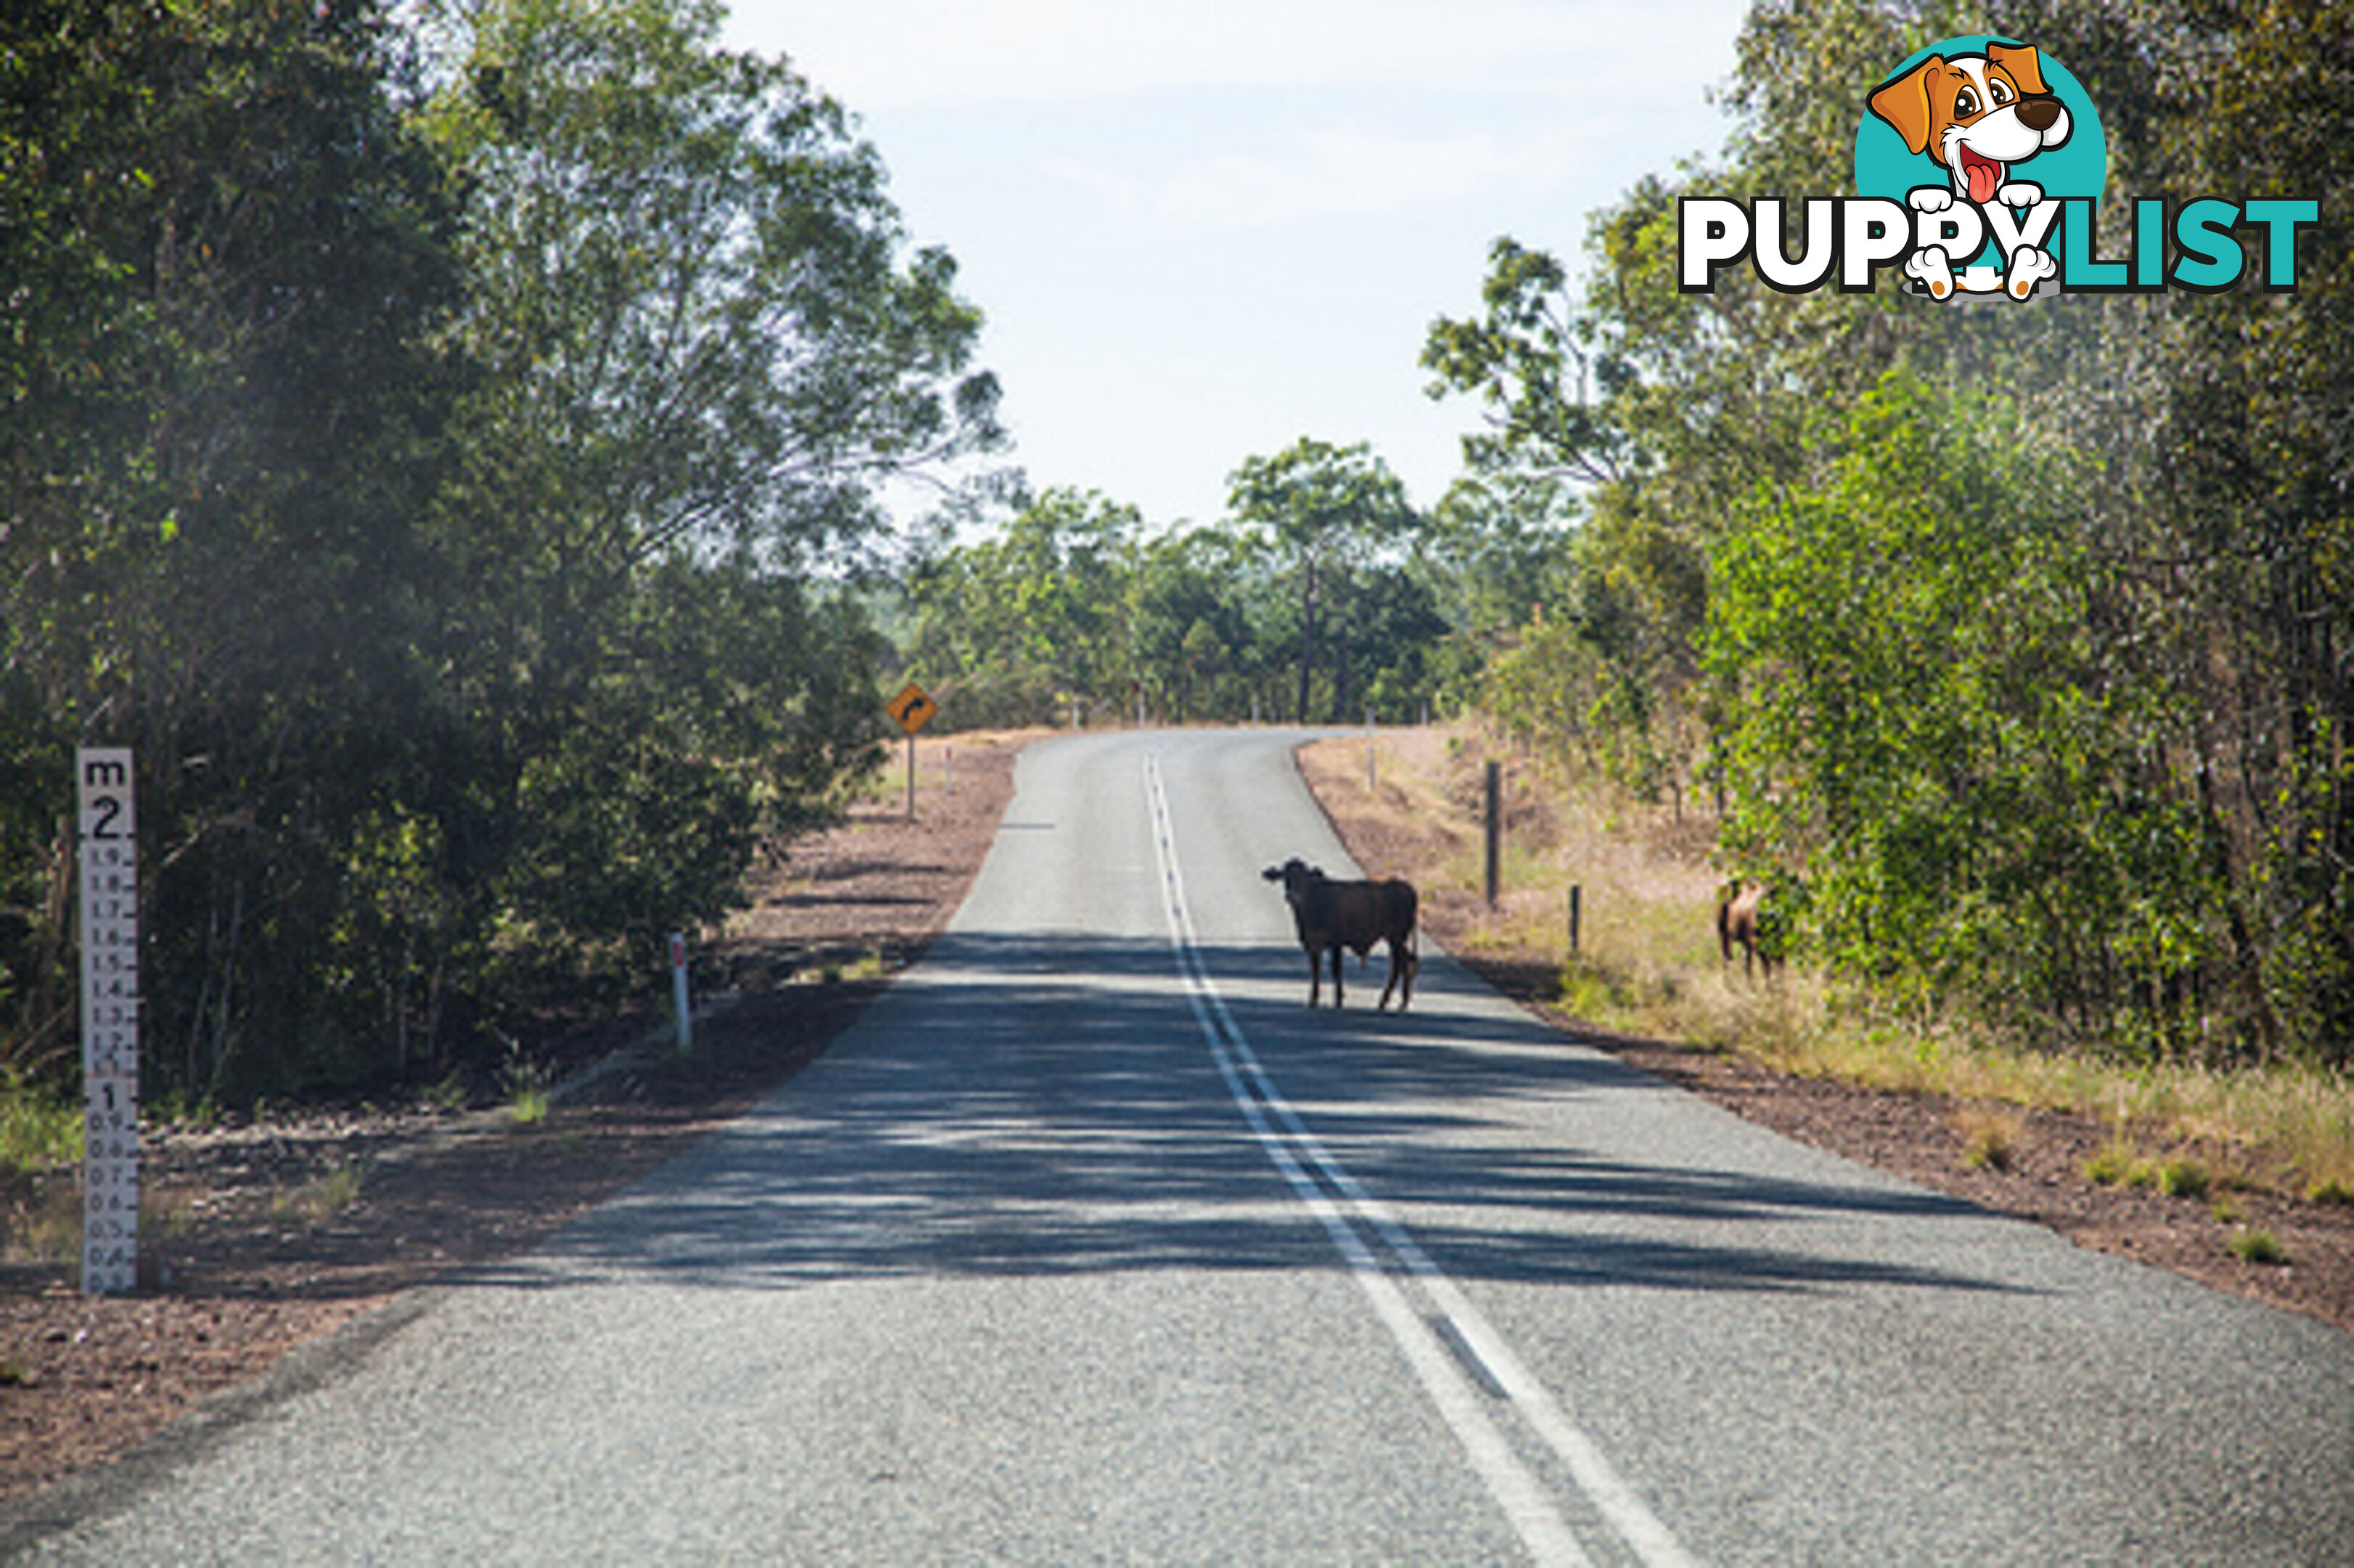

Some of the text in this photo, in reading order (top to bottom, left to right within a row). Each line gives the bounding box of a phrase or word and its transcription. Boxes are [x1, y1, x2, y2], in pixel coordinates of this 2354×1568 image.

[85, 761, 124, 787] m
[91, 795, 119, 838] 2
[102, 1082, 115, 1111] 1
